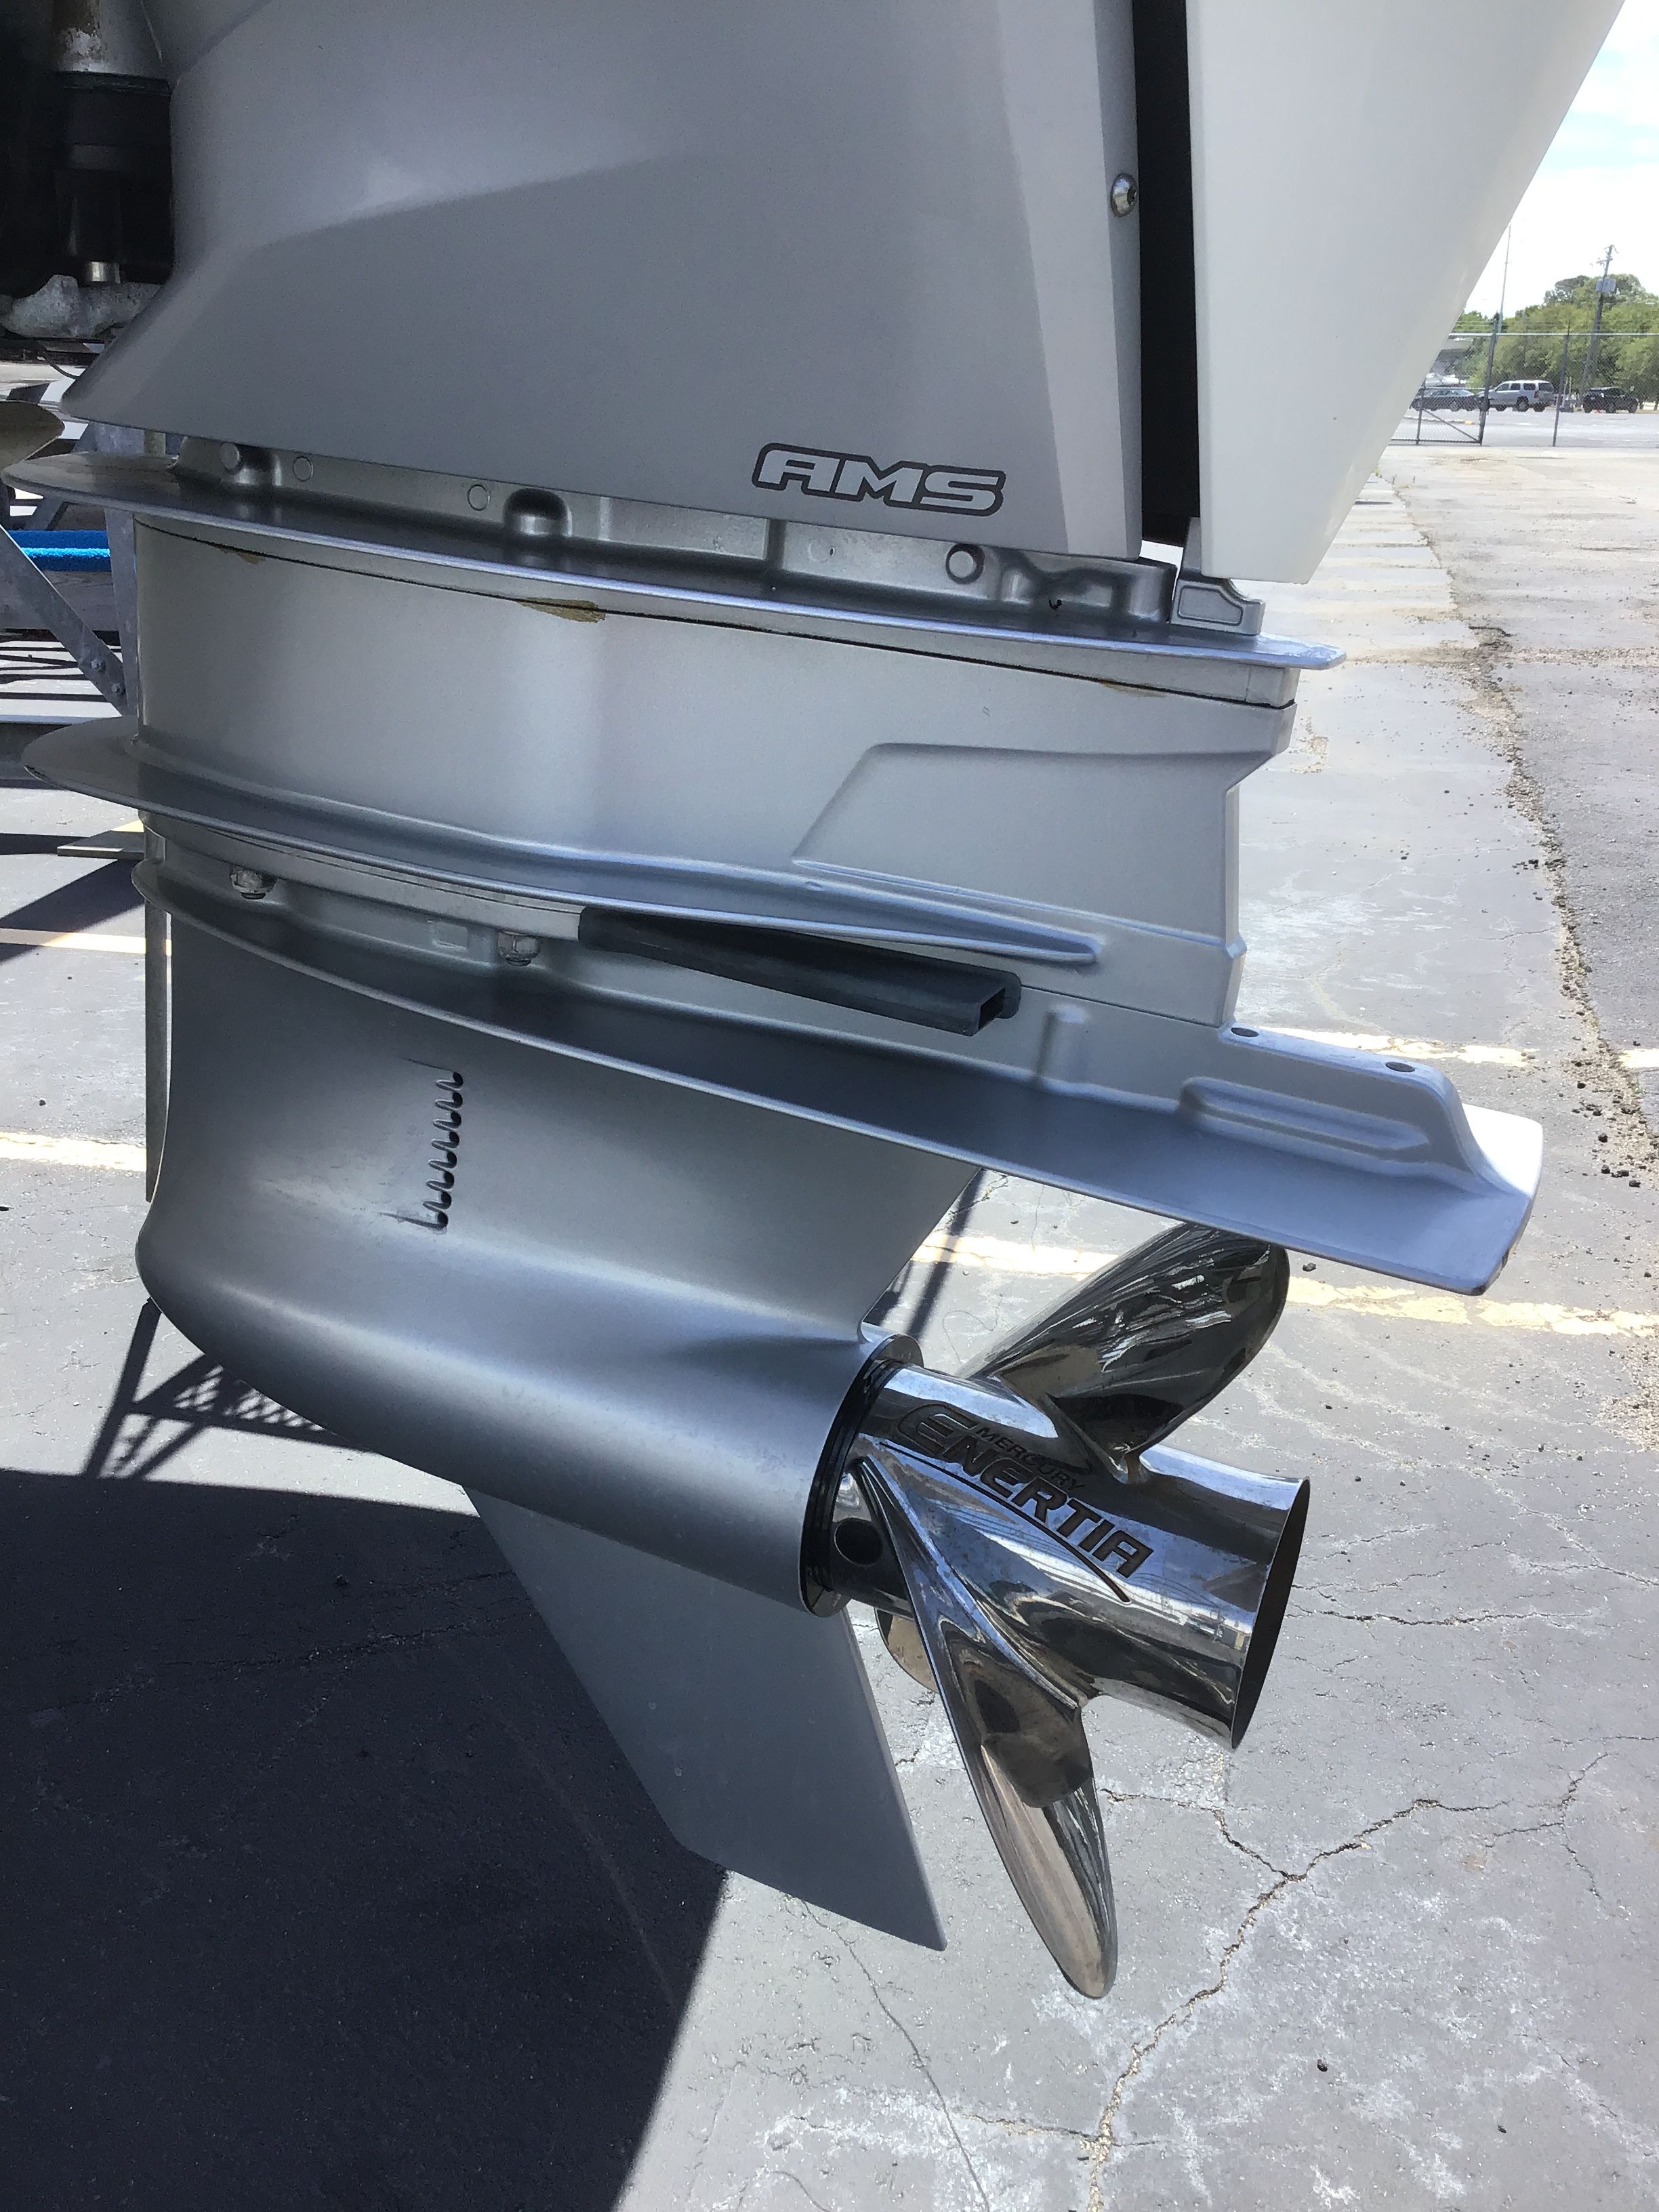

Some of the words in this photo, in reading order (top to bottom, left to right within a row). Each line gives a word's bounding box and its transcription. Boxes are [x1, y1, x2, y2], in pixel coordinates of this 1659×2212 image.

[752, 443, 1006, 516] AMS
[897, 1404, 1153, 1578] ENERTIA
[976, 1427, 1085, 1490] MERCURY
